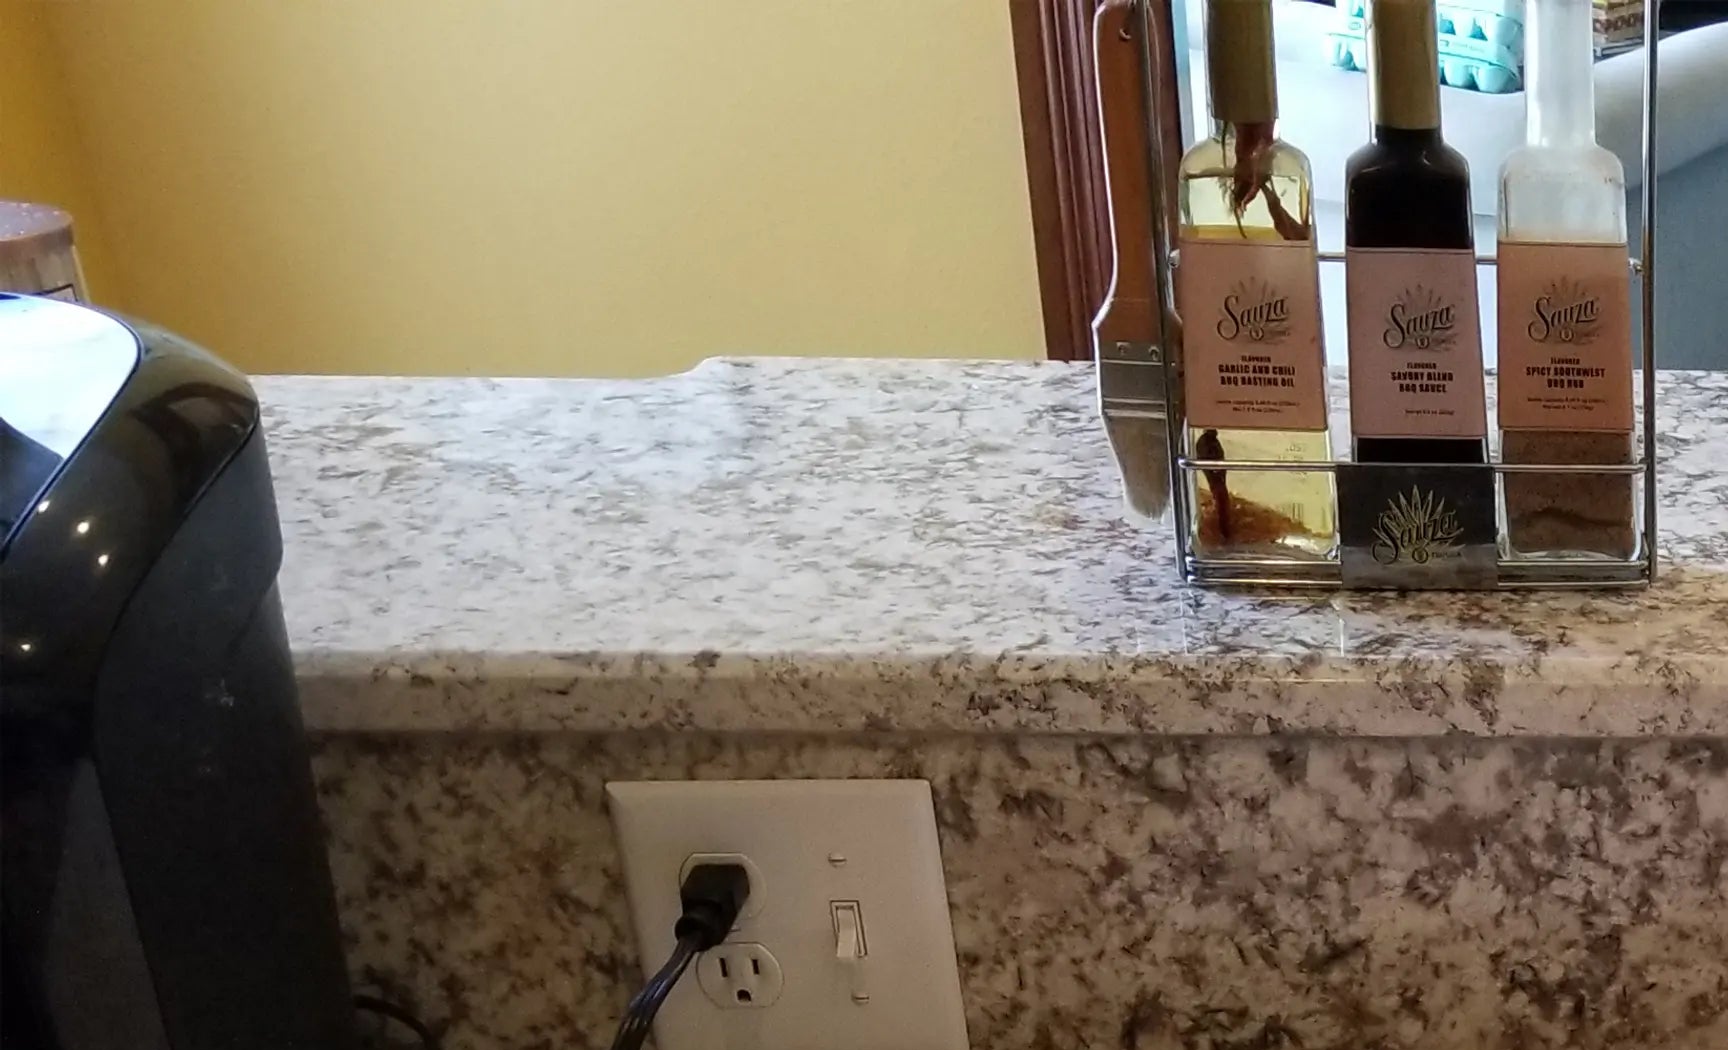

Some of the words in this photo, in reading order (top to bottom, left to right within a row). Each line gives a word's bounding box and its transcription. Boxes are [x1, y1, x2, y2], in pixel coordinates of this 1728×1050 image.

[1217, 295, 1289, 340] Sauza
[1528, 297, 1598, 343] Sauza
[1383, 303, 1454, 349] Sauza
[1218, 364, 1250, 373] GARLIC
[1252, 365, 1270, 374] AND
[1272, 366, 1295, 376] CHILI
[1391, 371, 1425, 381] SAVORY
[1427, 371, 1454, 381] BLEND
[1526, 366, 1551, 376] SPICY
[1553, 366, 1605, 378] SOUTHWEST
[1220, 376, 1238, 387] BBQ
[1241, 376, 1279, 387] BASTING
[1281, 377, 1294, 387] OIL
[1547, 378, 1565, 389] BBQ
[1399, 383, 1417, 393] BBQ
[1419, 383, 1447, 393] SAUCE
[1372, 511, 1459, 565] Sauza
